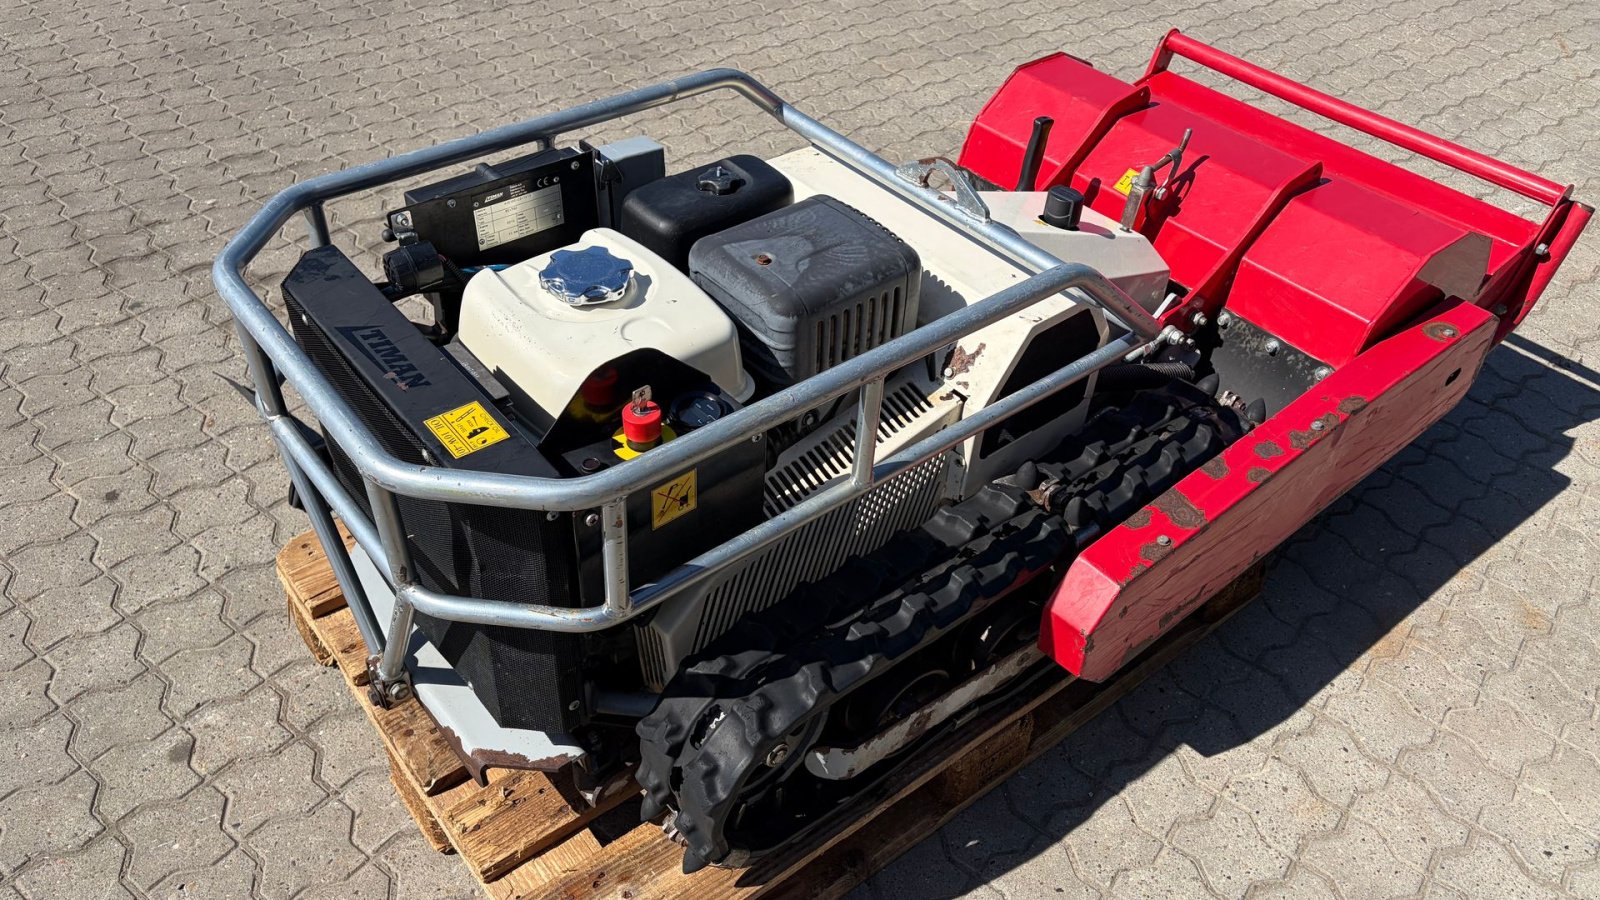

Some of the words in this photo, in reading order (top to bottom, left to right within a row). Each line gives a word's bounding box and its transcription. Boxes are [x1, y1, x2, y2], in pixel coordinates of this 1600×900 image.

[358, 327, 432, 388] TIMAN
[430, 419, 444, 432] OIL
[441, 430, 465, 455] 10W-40
